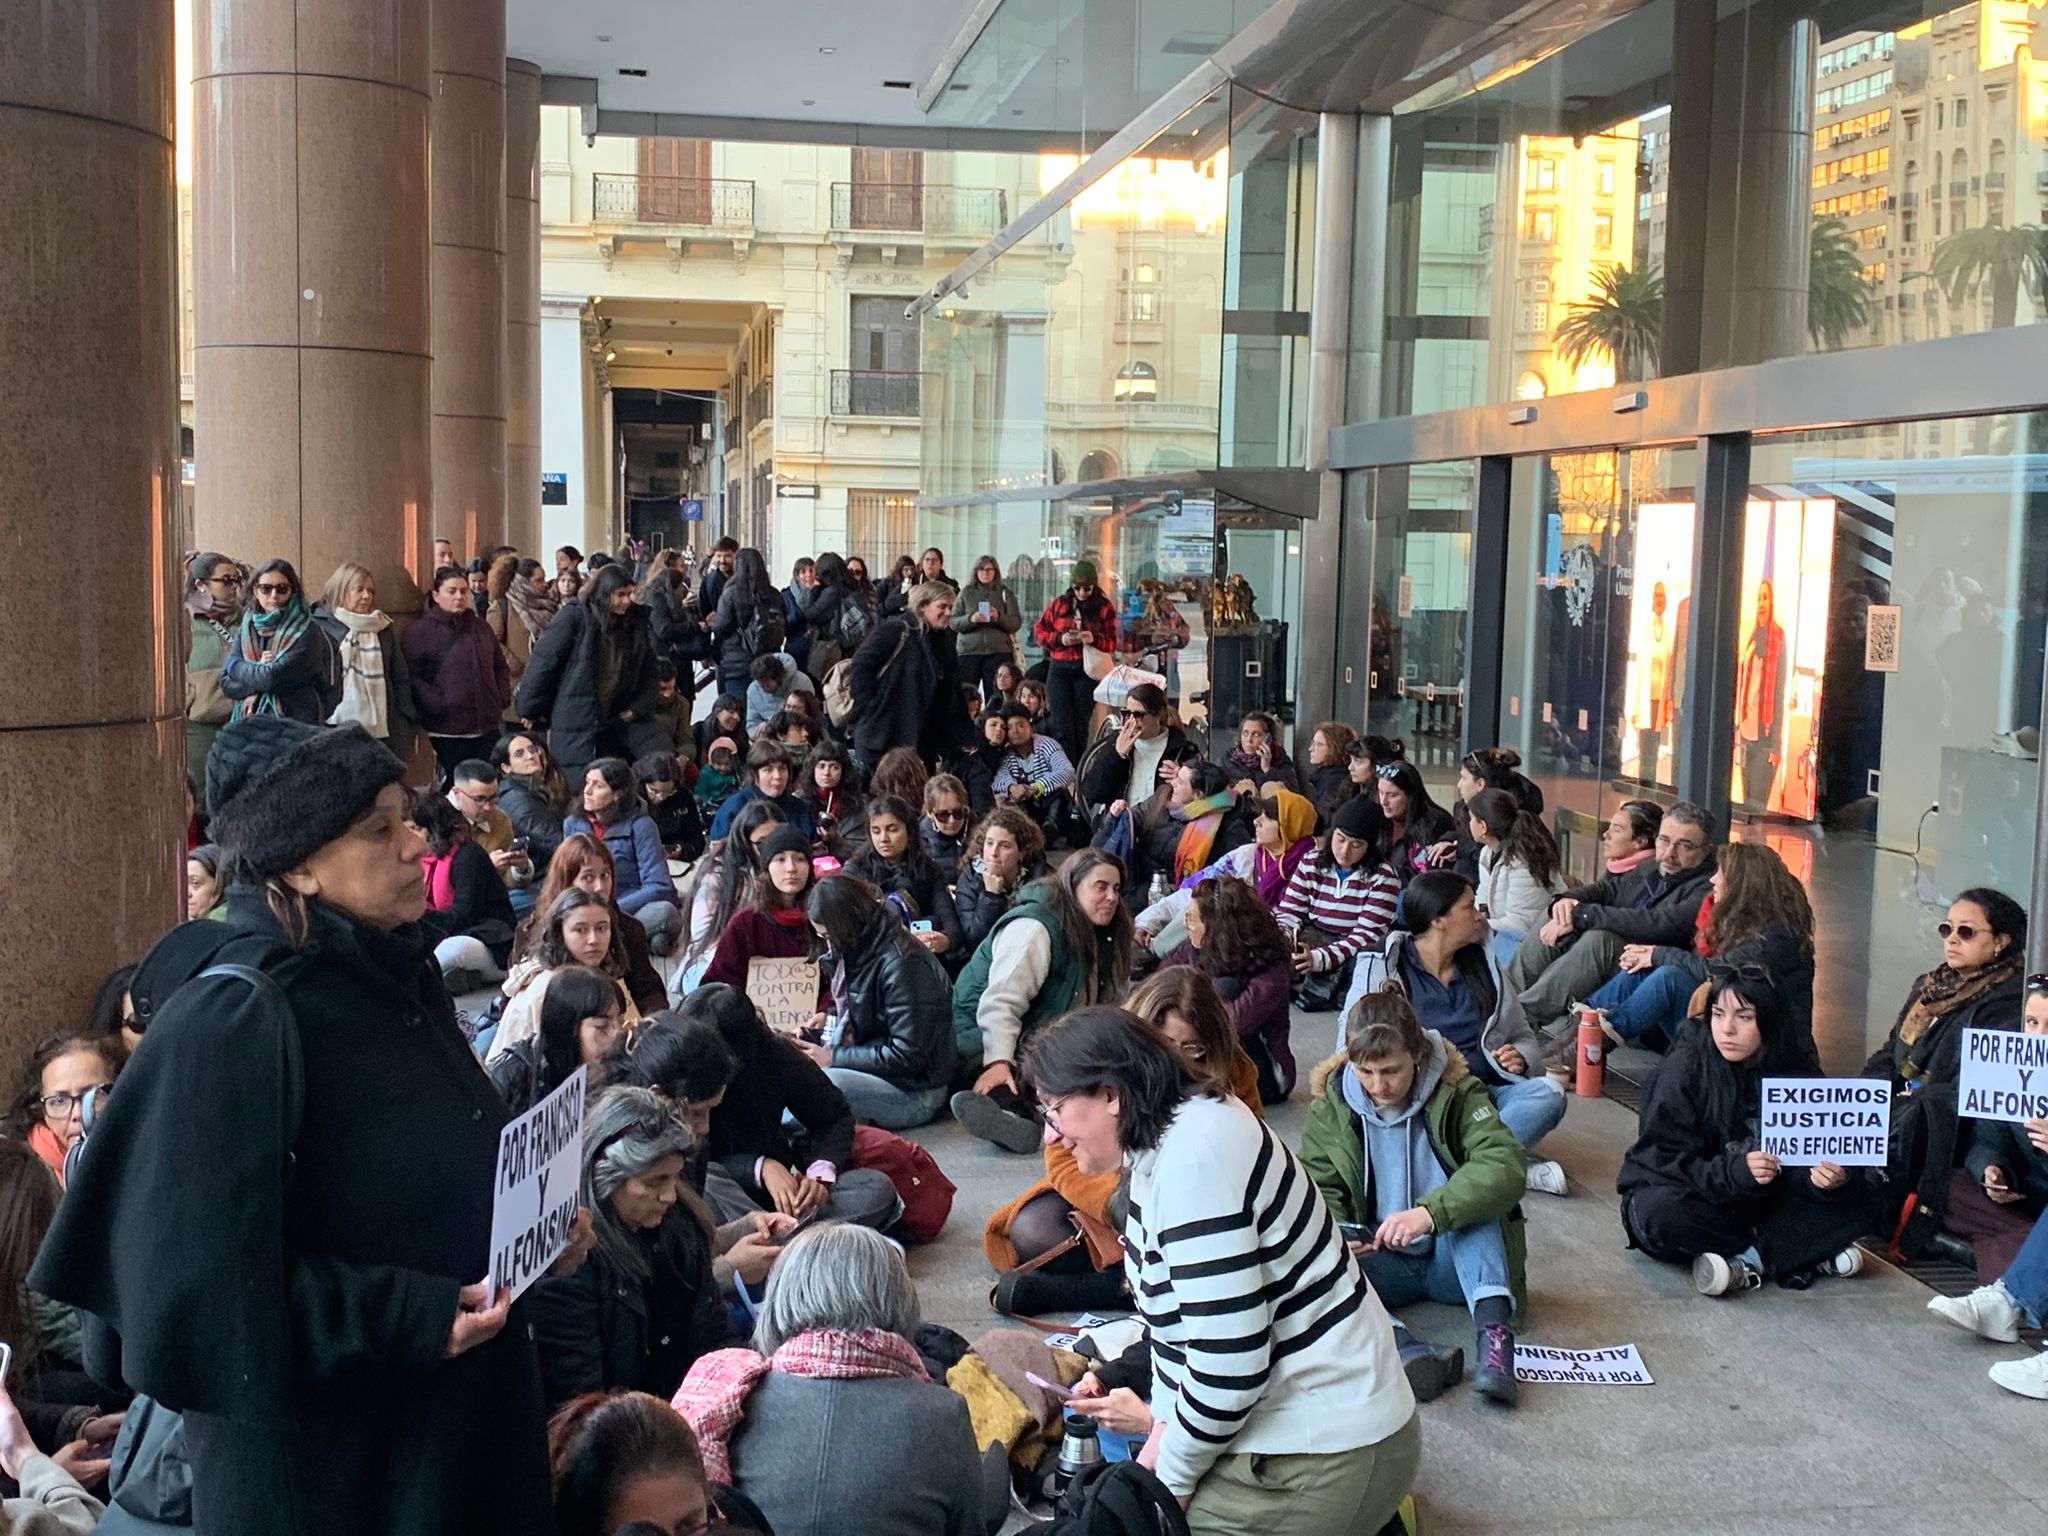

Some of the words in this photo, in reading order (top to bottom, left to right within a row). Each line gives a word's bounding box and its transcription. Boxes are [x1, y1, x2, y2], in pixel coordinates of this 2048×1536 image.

[748, 982, 814, 996] CONTRA
[768, 996, 790, 1008] LA
[1970, 1033, 2001, 1063] POR
[2005, 1036, 2048, 1067] FRAN
[2018, 1069, 2034, 1092] Y
[1767, 1088, 1888, 1104] EXIGIMOS
[1965, 1088, 2048, 1119] ALFONS
[1764, 1112, 1883, 1128] JUSTICIA
[499, 1121, 528, 1195] POR
[529, 1077, 581, 1176] FRANCISCO
[1765, 1137, 1799, 1155] MAS
[1803, 1136, 1885, 1155] EFICIENTE
[537, 1168, 551, 1217] Y
[493, 1189, 579, 1294] ALFONSINA
[1513, 1346, 1629, 1362] ALFONSINA
[1516, 1367, 1607, 1382] FRANCISCO
[1571, 1362, 1586, 1371] Y
[1609, 1370, 1643, 1382] POR
